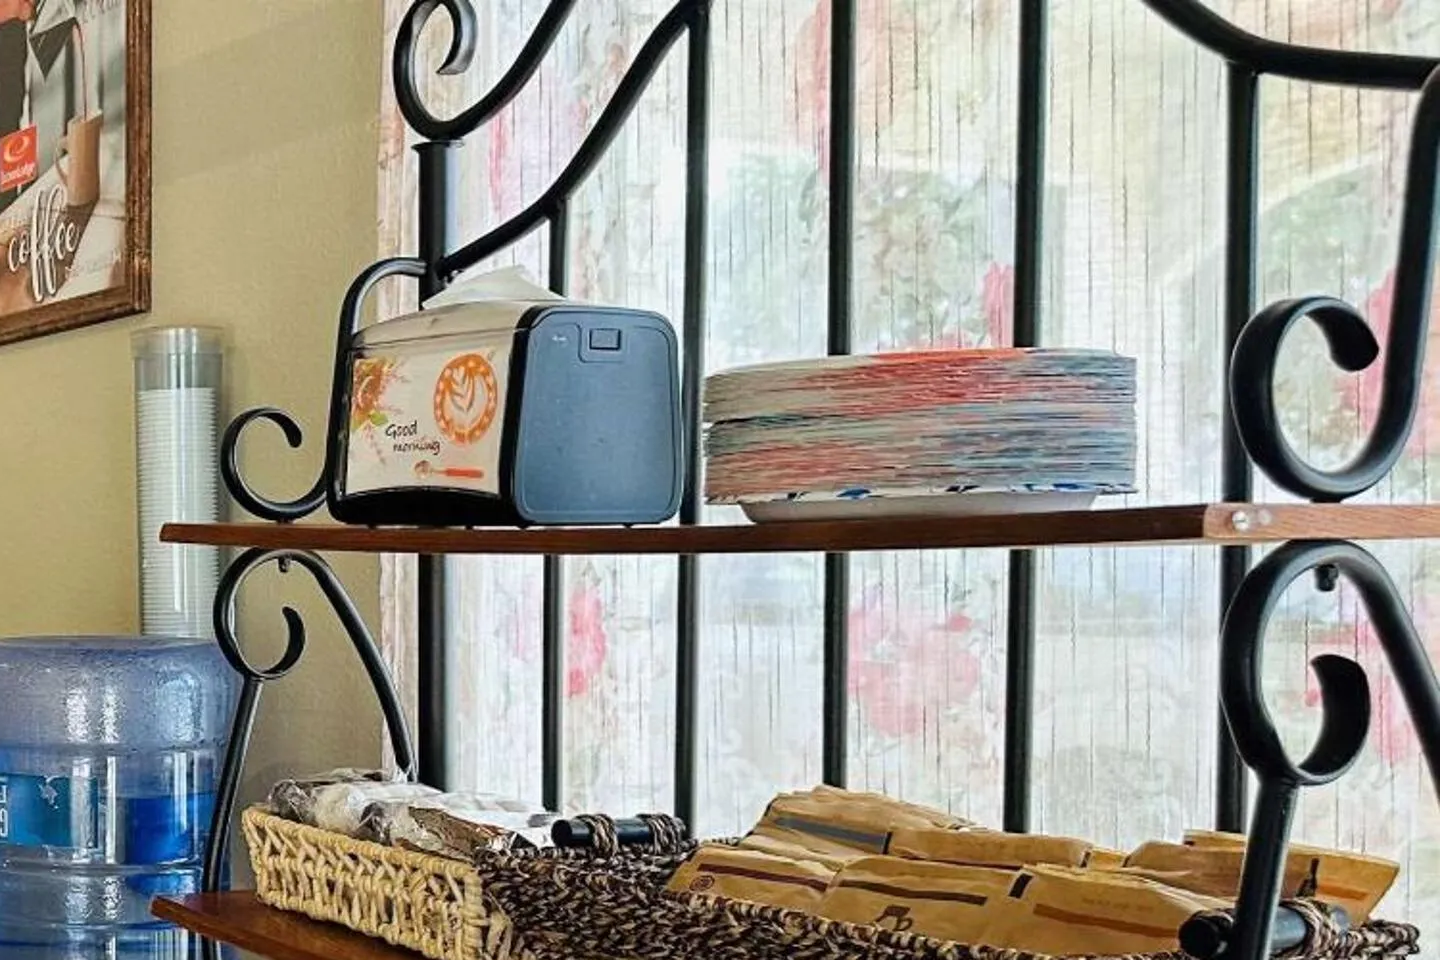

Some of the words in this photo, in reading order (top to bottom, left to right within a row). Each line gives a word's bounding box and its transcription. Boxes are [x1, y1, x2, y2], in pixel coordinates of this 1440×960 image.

[9, 184, 78, 302] coffee
[385, 420, 418, 439] Good
[393, 441, 440, 456] morning
